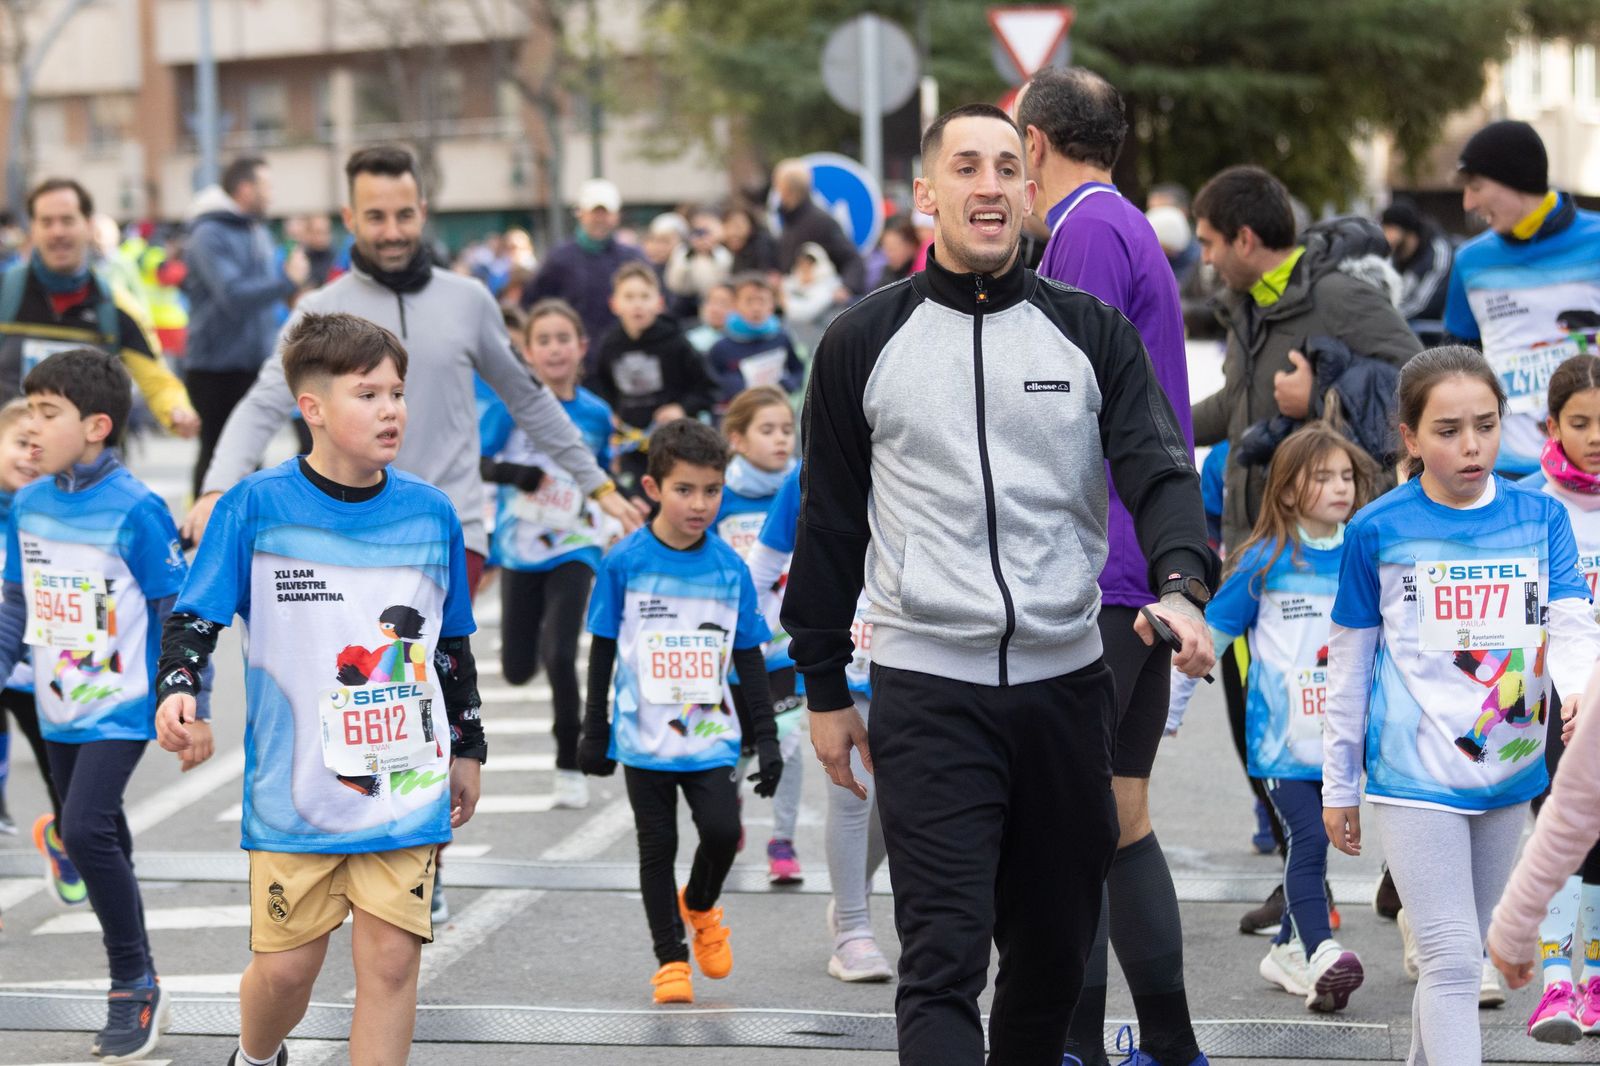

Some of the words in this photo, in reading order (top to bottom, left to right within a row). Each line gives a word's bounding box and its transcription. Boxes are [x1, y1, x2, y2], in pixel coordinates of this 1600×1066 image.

[1026, 382, 1057, 391] ellesse
[274, 570, 291, 579] XLI
[292, 569, 314, 578] SAN
[1449, 564, 1527, 580] SETEL
[41, 576, 96, 589] SETEL
[1402, 575, 1414, 584] XLI
[275, 581, 327, 591] SILVESTRE
[277, 592, 345, 602] SALMANTINA
[1434, 583, 1510, 620] 6677
[36, 590, 82, 623] 6945
[1460, 620, 1487, 628] PAULA
[665, 635, 719, 647] SETEL
[1480, 640, 1505, 648] Salamanca
[652, 651, 714, 679] 6836
[353, 685, 423, 706] SETEL
[343, 704, 408, 746] 6612
